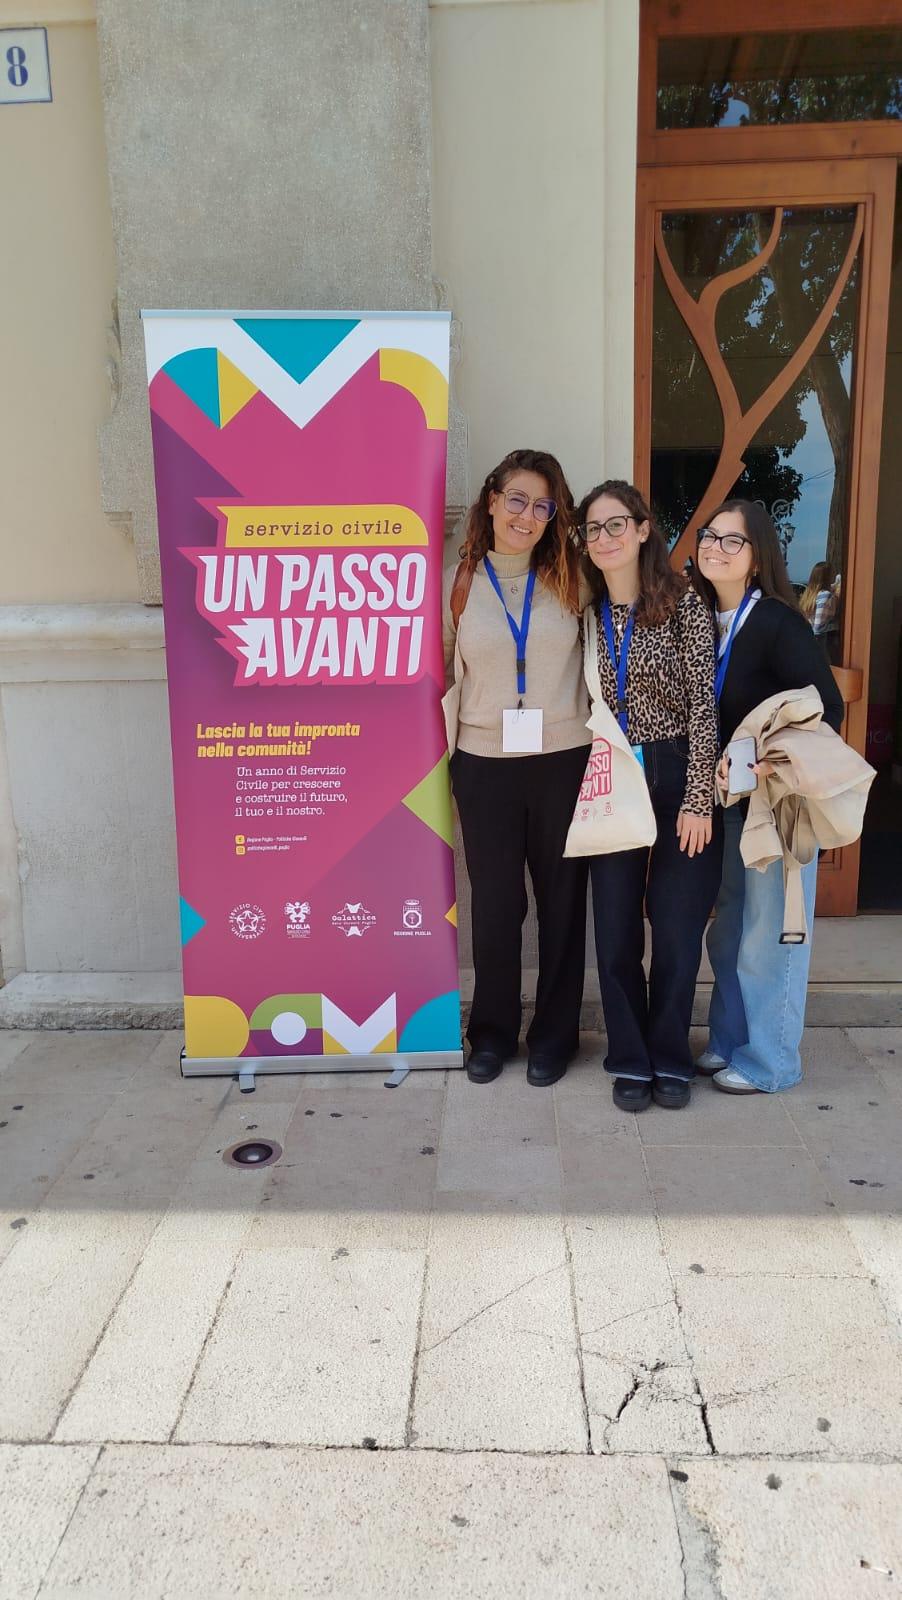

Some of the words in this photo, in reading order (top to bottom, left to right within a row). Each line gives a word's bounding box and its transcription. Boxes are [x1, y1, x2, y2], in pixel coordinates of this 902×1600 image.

[6, 46, 28, 87] 8
[244, 522, 334, 536] servizio
[342, 519, 403, 535] civile
[198, 555, 268, 612] UN
[274, 553, 427, 611] PASSO
[227, 616, 425, 678] AVANTI
[196, 722, 246, 739] Lascia
[249, 722, 263, 738] la
[266, 723, 291, 737] tua
[294, 721, 361, 740] impronta
[197, 742, 234, 758] nella
[236, 740, 312, 756] comunità!
[237, 766, 253, 776] Un
[255, 766, 284, 776] anno
[286, 765, 297, 776] di
[300, 765, 346, 775] Servizio
[236, 780, 268, 790] Civile
[271, 780, 290, 791] per
[293, 780, 341, 789] crescere
[235, 796, 242, 804] e
[244, 793, 297, 803] costruire
[300, 792, 307, 802] il
[309, 792, 348, 803] futuro,
[235, 807, 243, 817] il
[245, 808, 264, 816] tuo
[276, 806, 283, 816] il
[286, 806, 326, 815] nostro.
